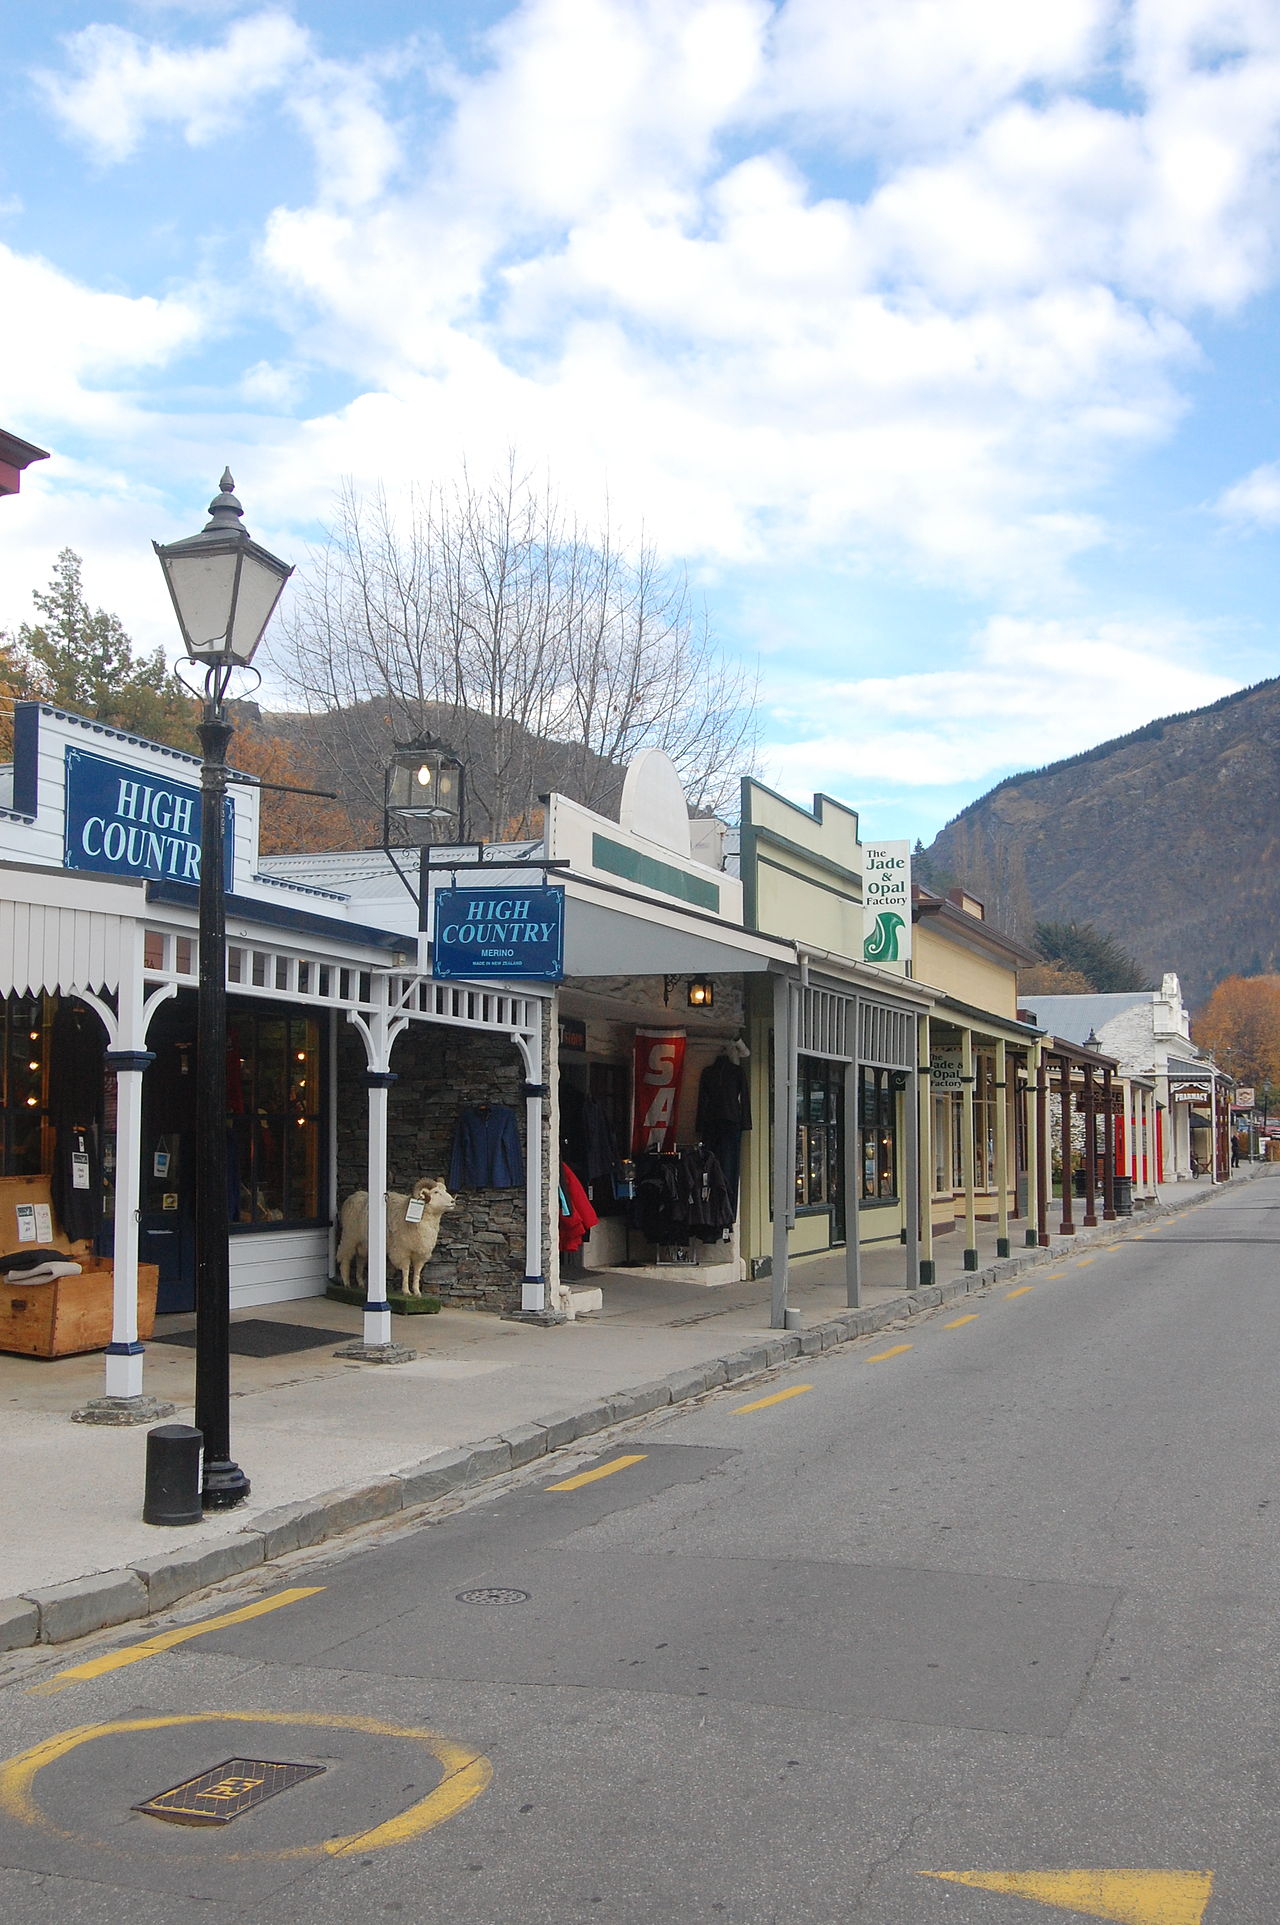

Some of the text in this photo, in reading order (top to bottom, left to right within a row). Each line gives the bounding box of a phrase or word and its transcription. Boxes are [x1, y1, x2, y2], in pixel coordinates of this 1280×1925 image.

[114, 778, 194, 836] HIGH
[81, 816, 202, 880] COUNTR
[866, 849, 887, 858] The
[866, 857, 905, 871] Jade
[881, 872, 893, 882] &
[868, 881, 905, 897] Opal
[866, 897, 908, 906] Factory
[466, 900, 532, 921] HIGH
[442, 922, 556, 944] COUNTRY
[481, 949, 514, 957] MERINO
[933, 1070, 961, 1080] Opal
